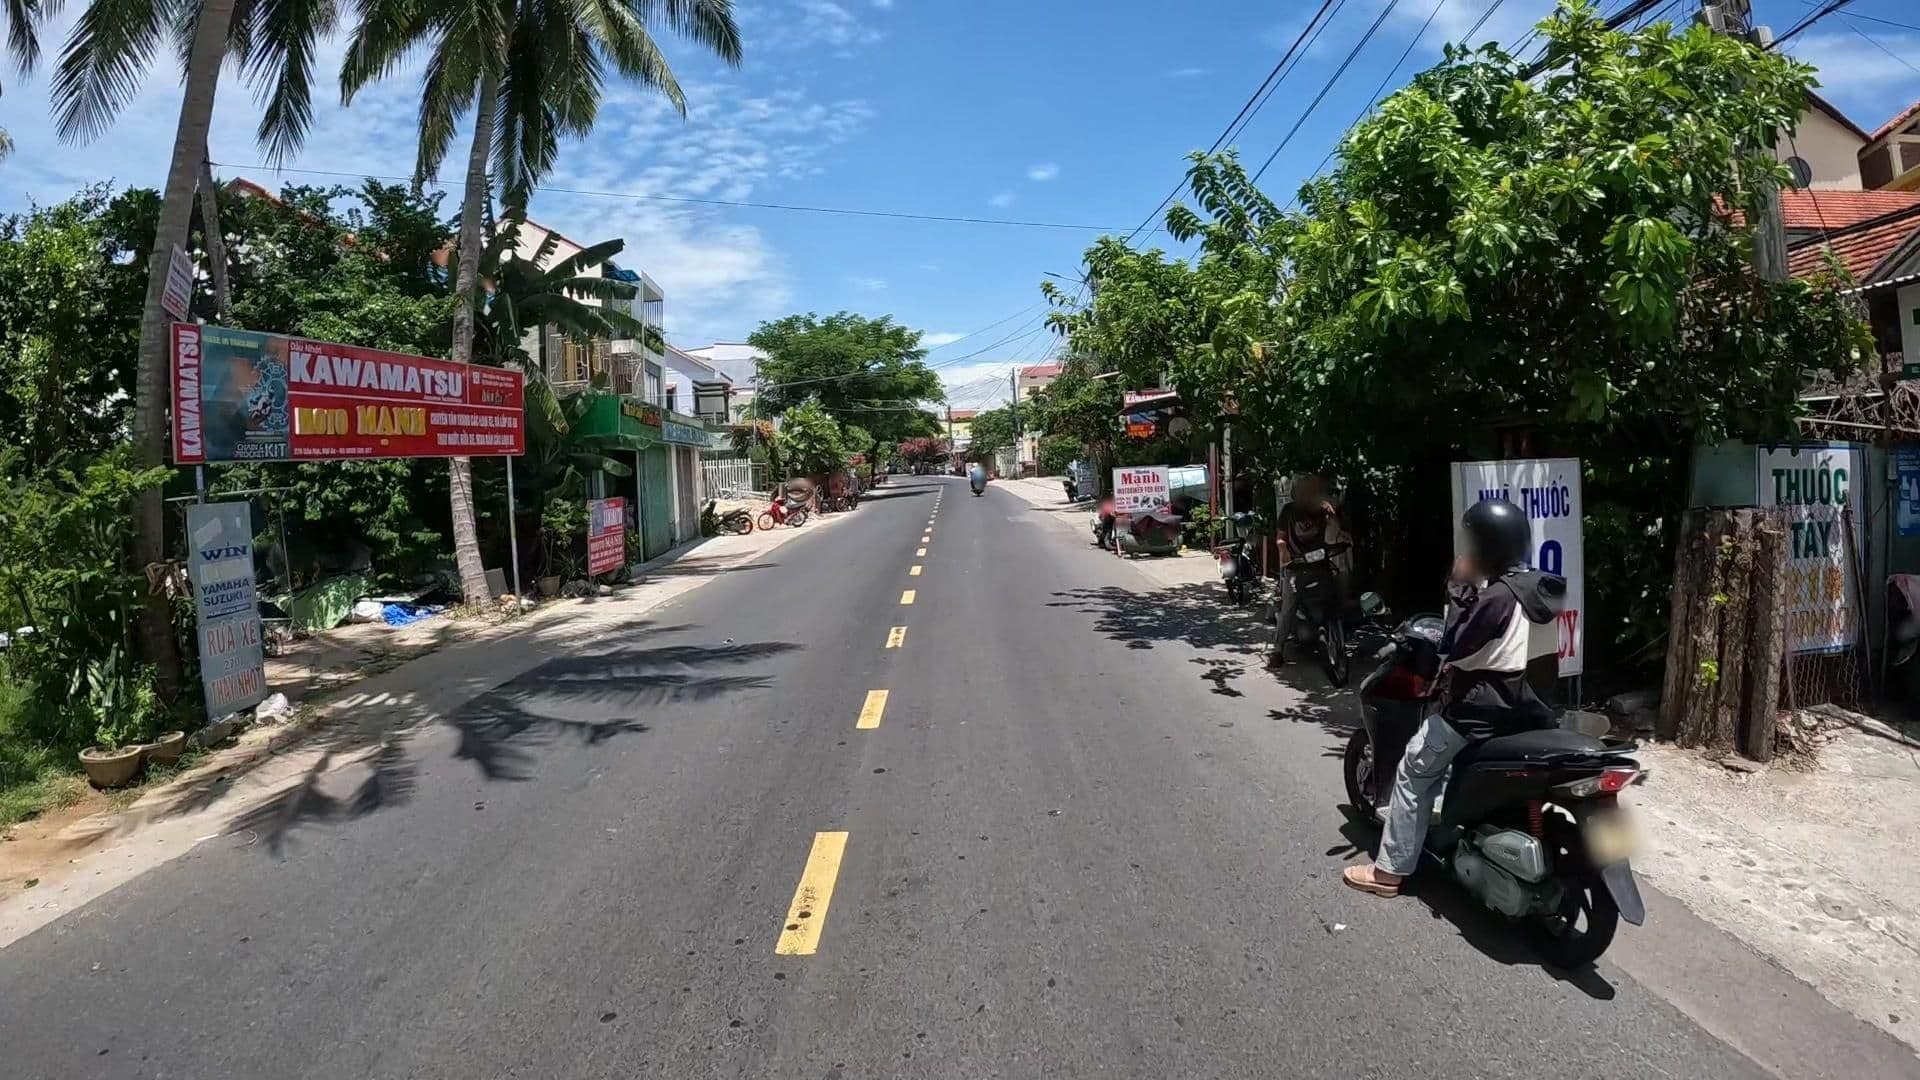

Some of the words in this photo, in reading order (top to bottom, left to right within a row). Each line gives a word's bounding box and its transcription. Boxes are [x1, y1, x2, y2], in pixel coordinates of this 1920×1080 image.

[179, 330, 202, 456] KAWAMATSU
[289, 351, 463, 397] KAWAMATSU
[264, 443, 286, 457] KIT
[1521, 475, 1570, 519] THUỐC
[1772, 456, 1848, 505] THUỐC
[201, 578, 250, 596] YAMAHA
[241, 619, 257, 647] XE
